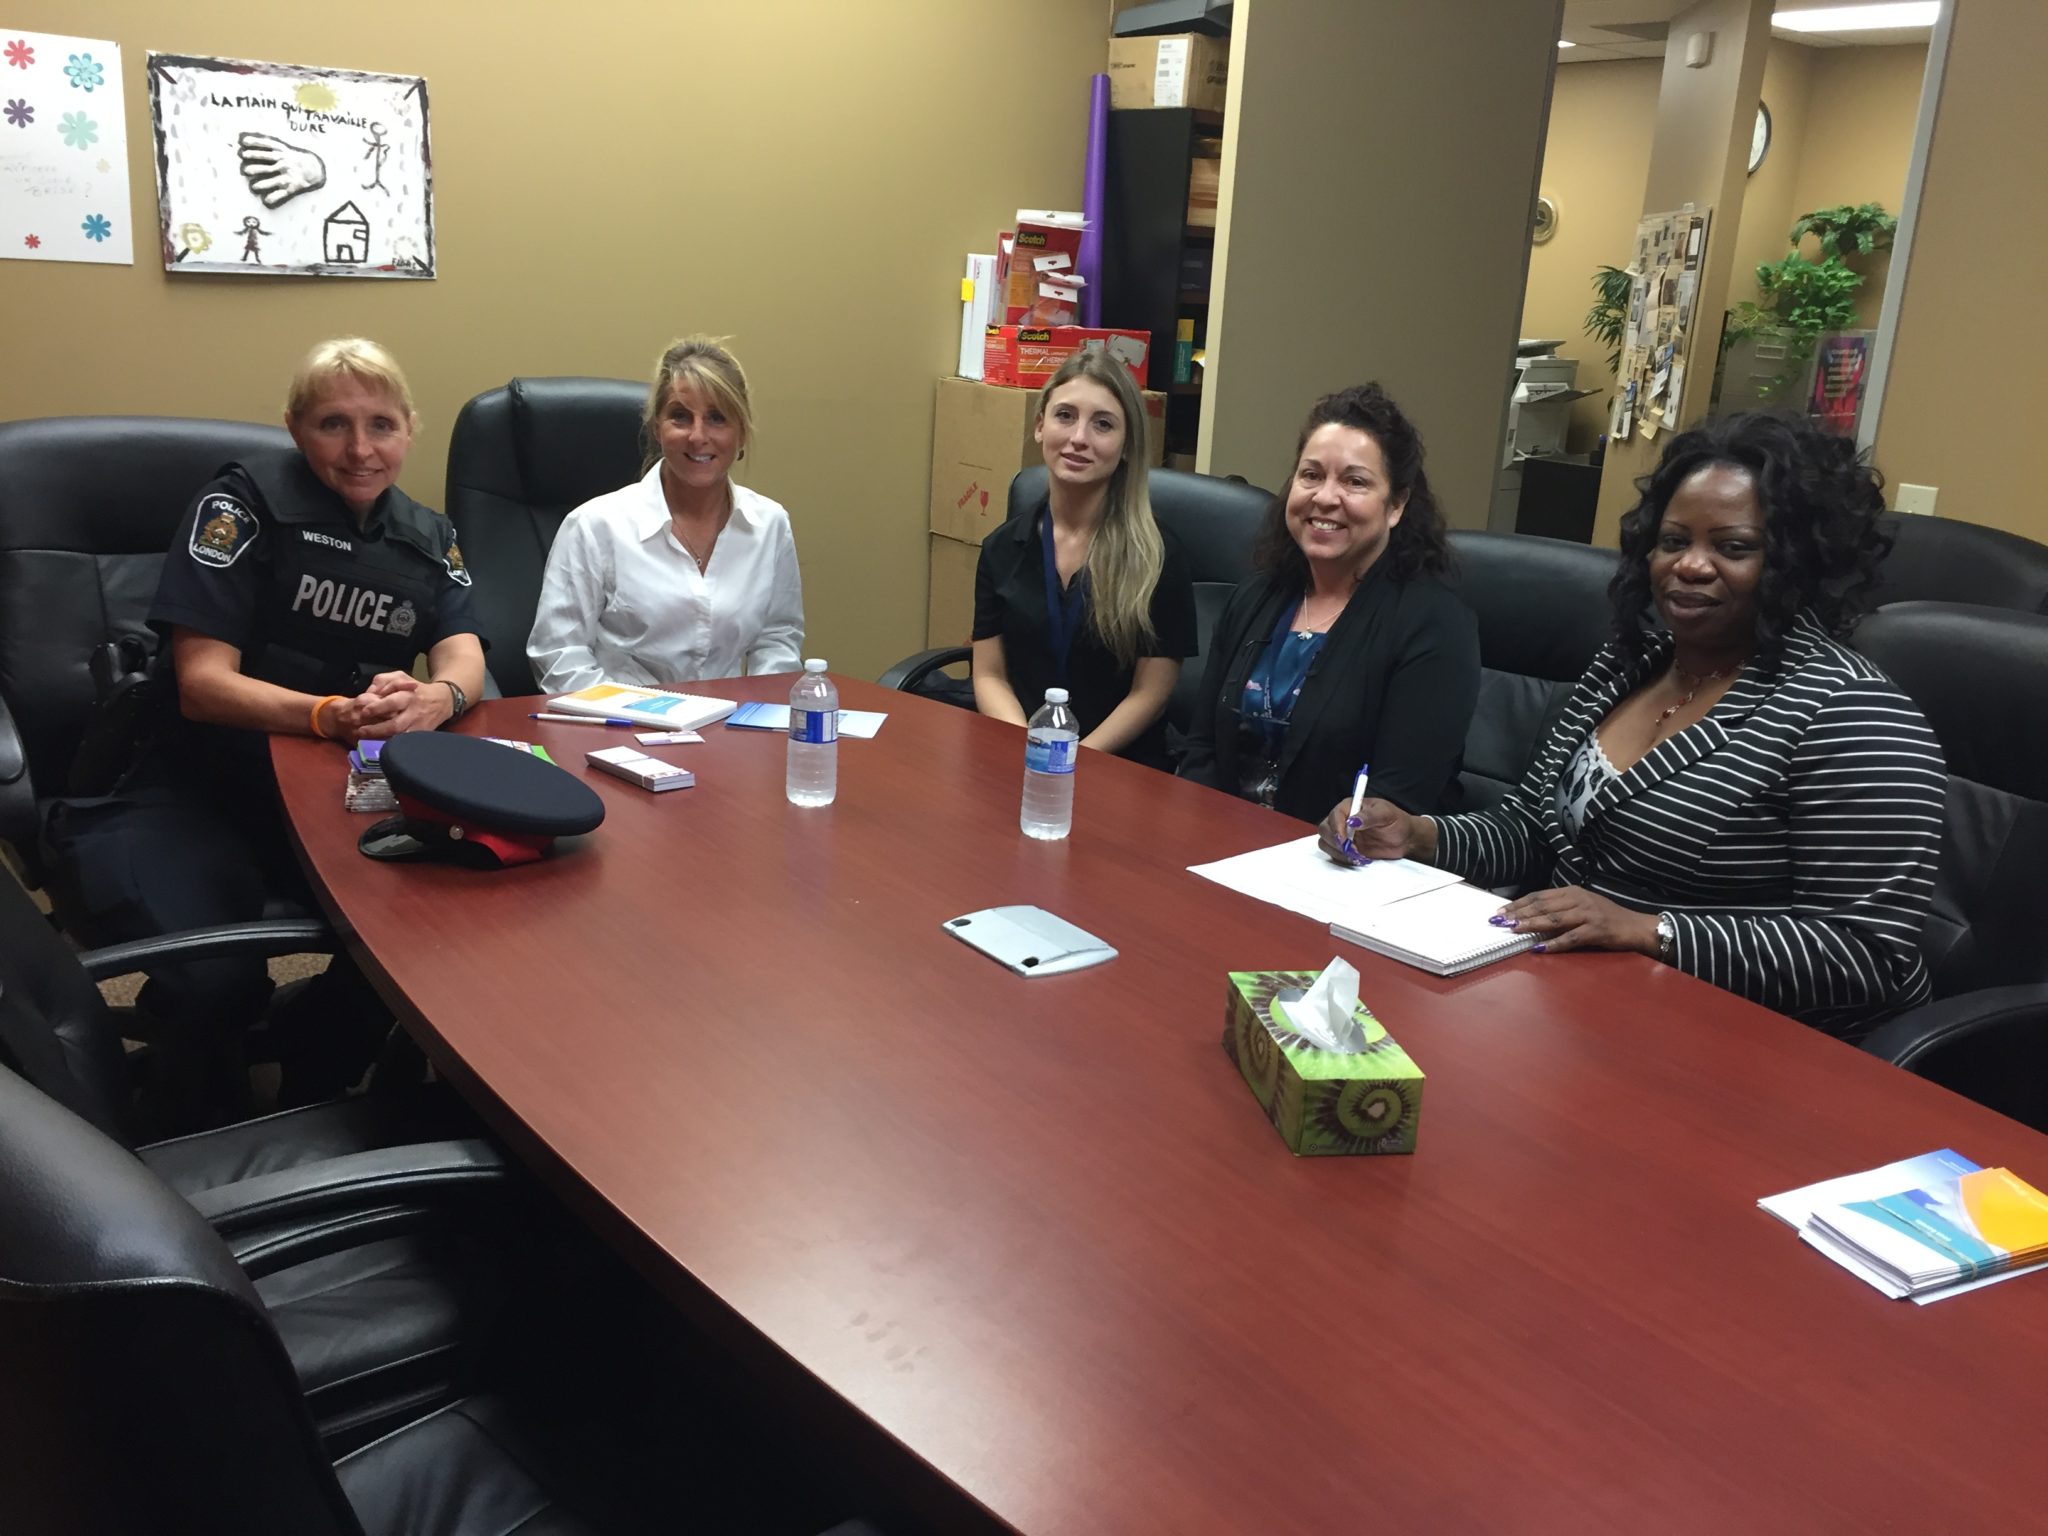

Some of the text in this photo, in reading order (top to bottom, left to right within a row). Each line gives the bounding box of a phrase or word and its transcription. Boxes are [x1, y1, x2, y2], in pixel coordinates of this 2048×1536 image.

[211, 92, 234, 108] LA
[289, 120, 327, 134] DURE
[1018, 233, 1045, 246] Scotch
[1021, 331, 1049, 342] Scotch
[1020, 347, 1050, 356] THERMAL
[211, 500, 250, 524] POLICE
[302, 530, 352, 552] WESTON
[193, 544, 231, 563] LONDON
[292, 574, 393, 632] POLICE
